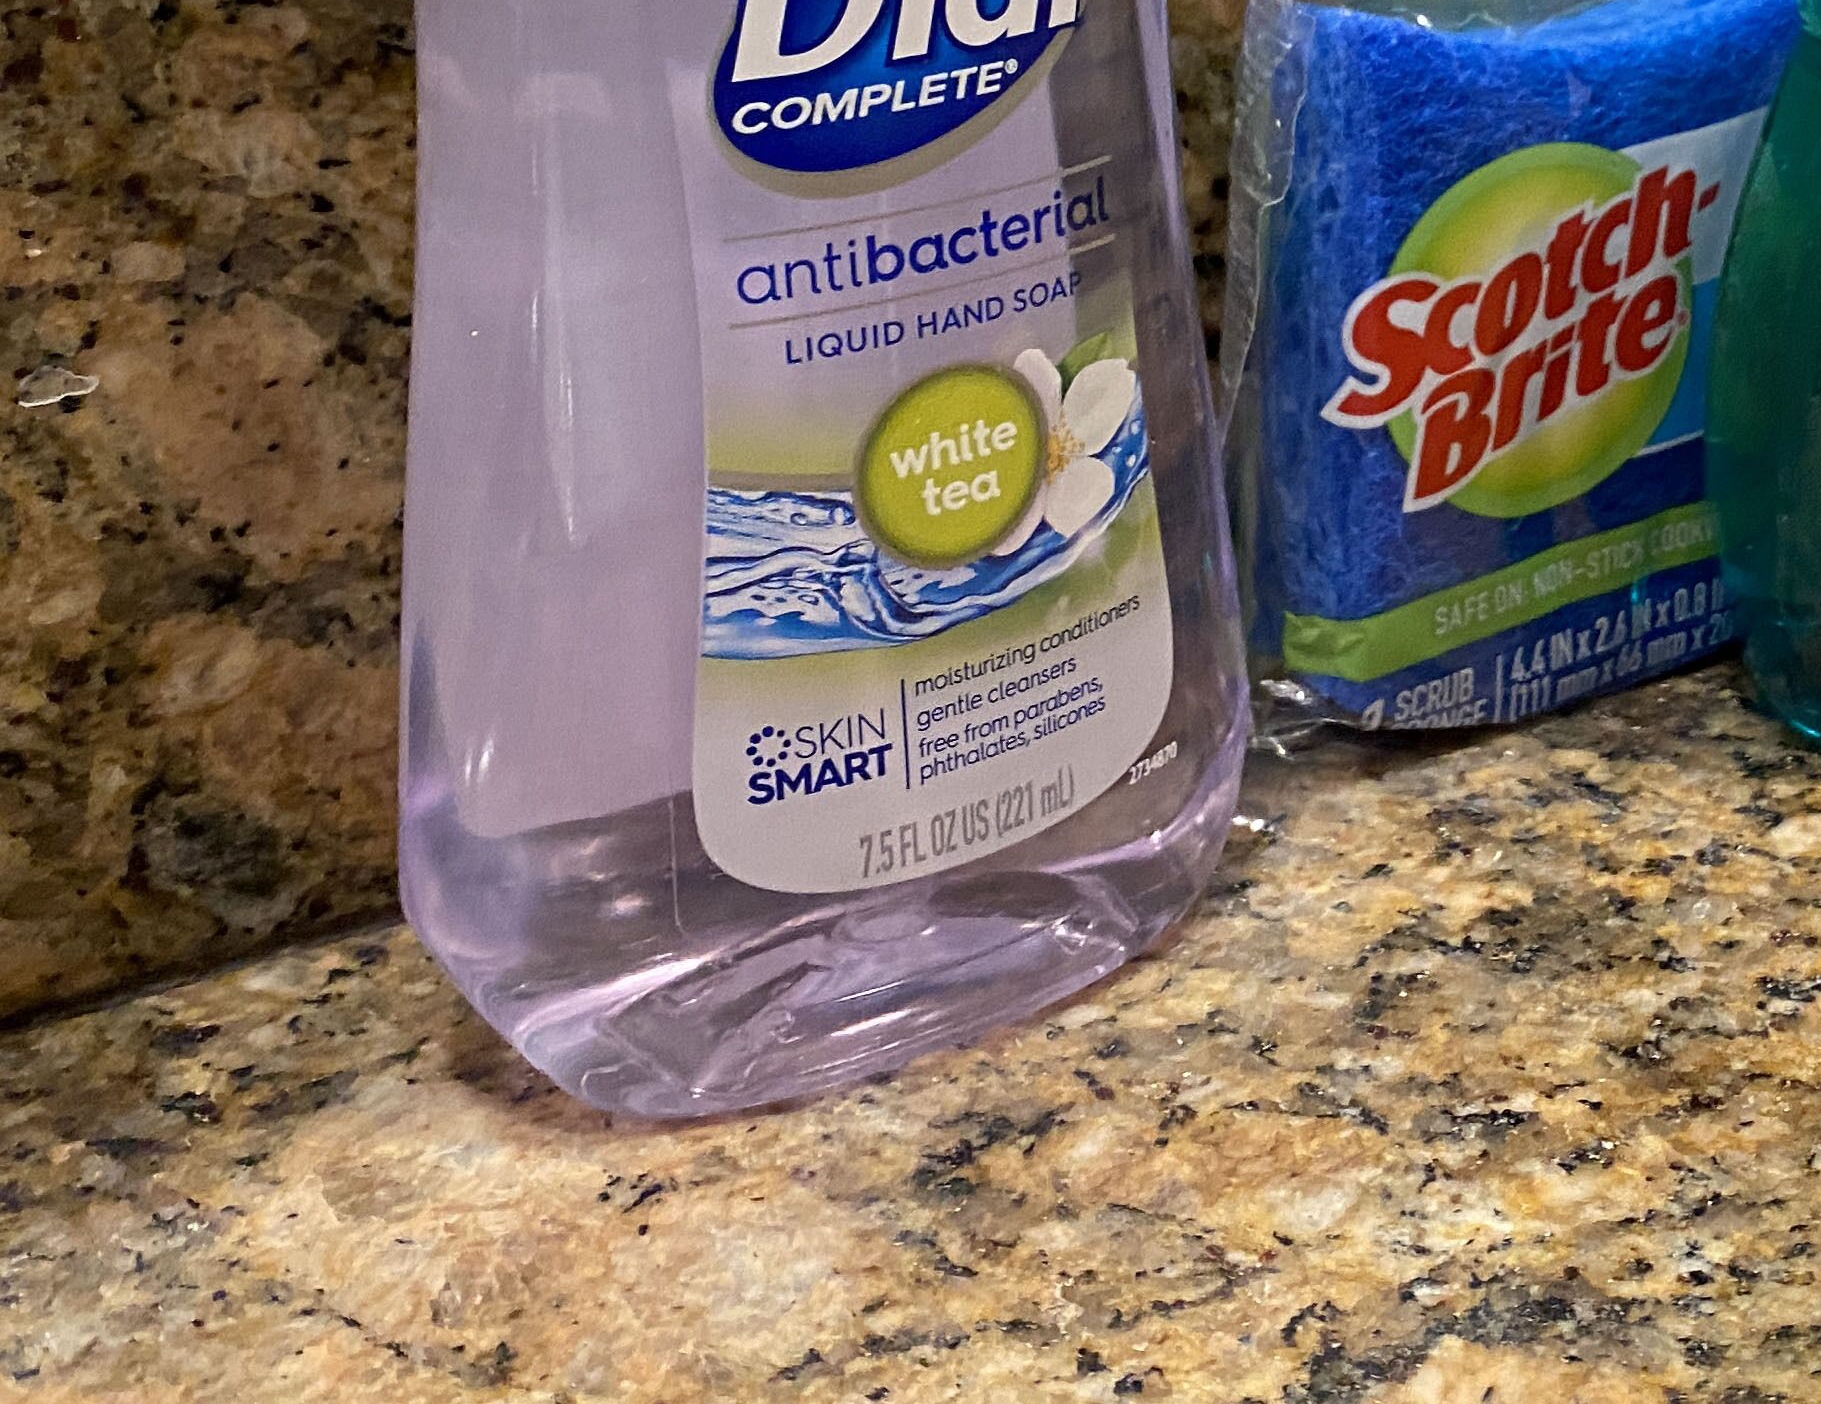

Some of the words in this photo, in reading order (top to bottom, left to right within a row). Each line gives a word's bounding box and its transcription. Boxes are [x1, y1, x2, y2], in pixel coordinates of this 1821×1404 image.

[736, 177, 1110, 304] antibacterial
[785, 320, 904, 365] LIQUID
[917, 295, 1005, 339] HAND
[1012, 271, 1082, 313] SOAP
[890, 419, 1018, 478] white
[922, 469, 1001, 515] tea
[915, 642, 1037, 696] moisturizing
[1039, 594, 1141, 654] conditioners
[1434, 592, 1488, 636] SAFE
[1495, 581, 1523, 614] ON
[1550, 627, 1574, 673] IN
[1631, 597, 1652, 640] IN
[916, 693, 983, 732] gentle
[987, 656, 1077, 703] cleansers
[918, 732, 959, 758] free
[964, 714, 1009, 743] from
[1013, 675, 1103, 730] parabens,
[1393, 667, 1474, 722] SCRUB
[1555, 666, 1600, 703] mm
[795, 707, 887, 760] SKIN
[919, 730, 1031, 786] phthalates,
[1033, 696, 1106, 741] silicones
[747, 743, 893, 805] SMART
[859, 829, 894, 878] 7.5
[899, 821, 927, 867] FL
[930, 809, 958, 857] OZ
[961, 799, 990, 846] US
[995, 779, 1034, 838] (221
[1039, 764, 1076, 818] mL)
